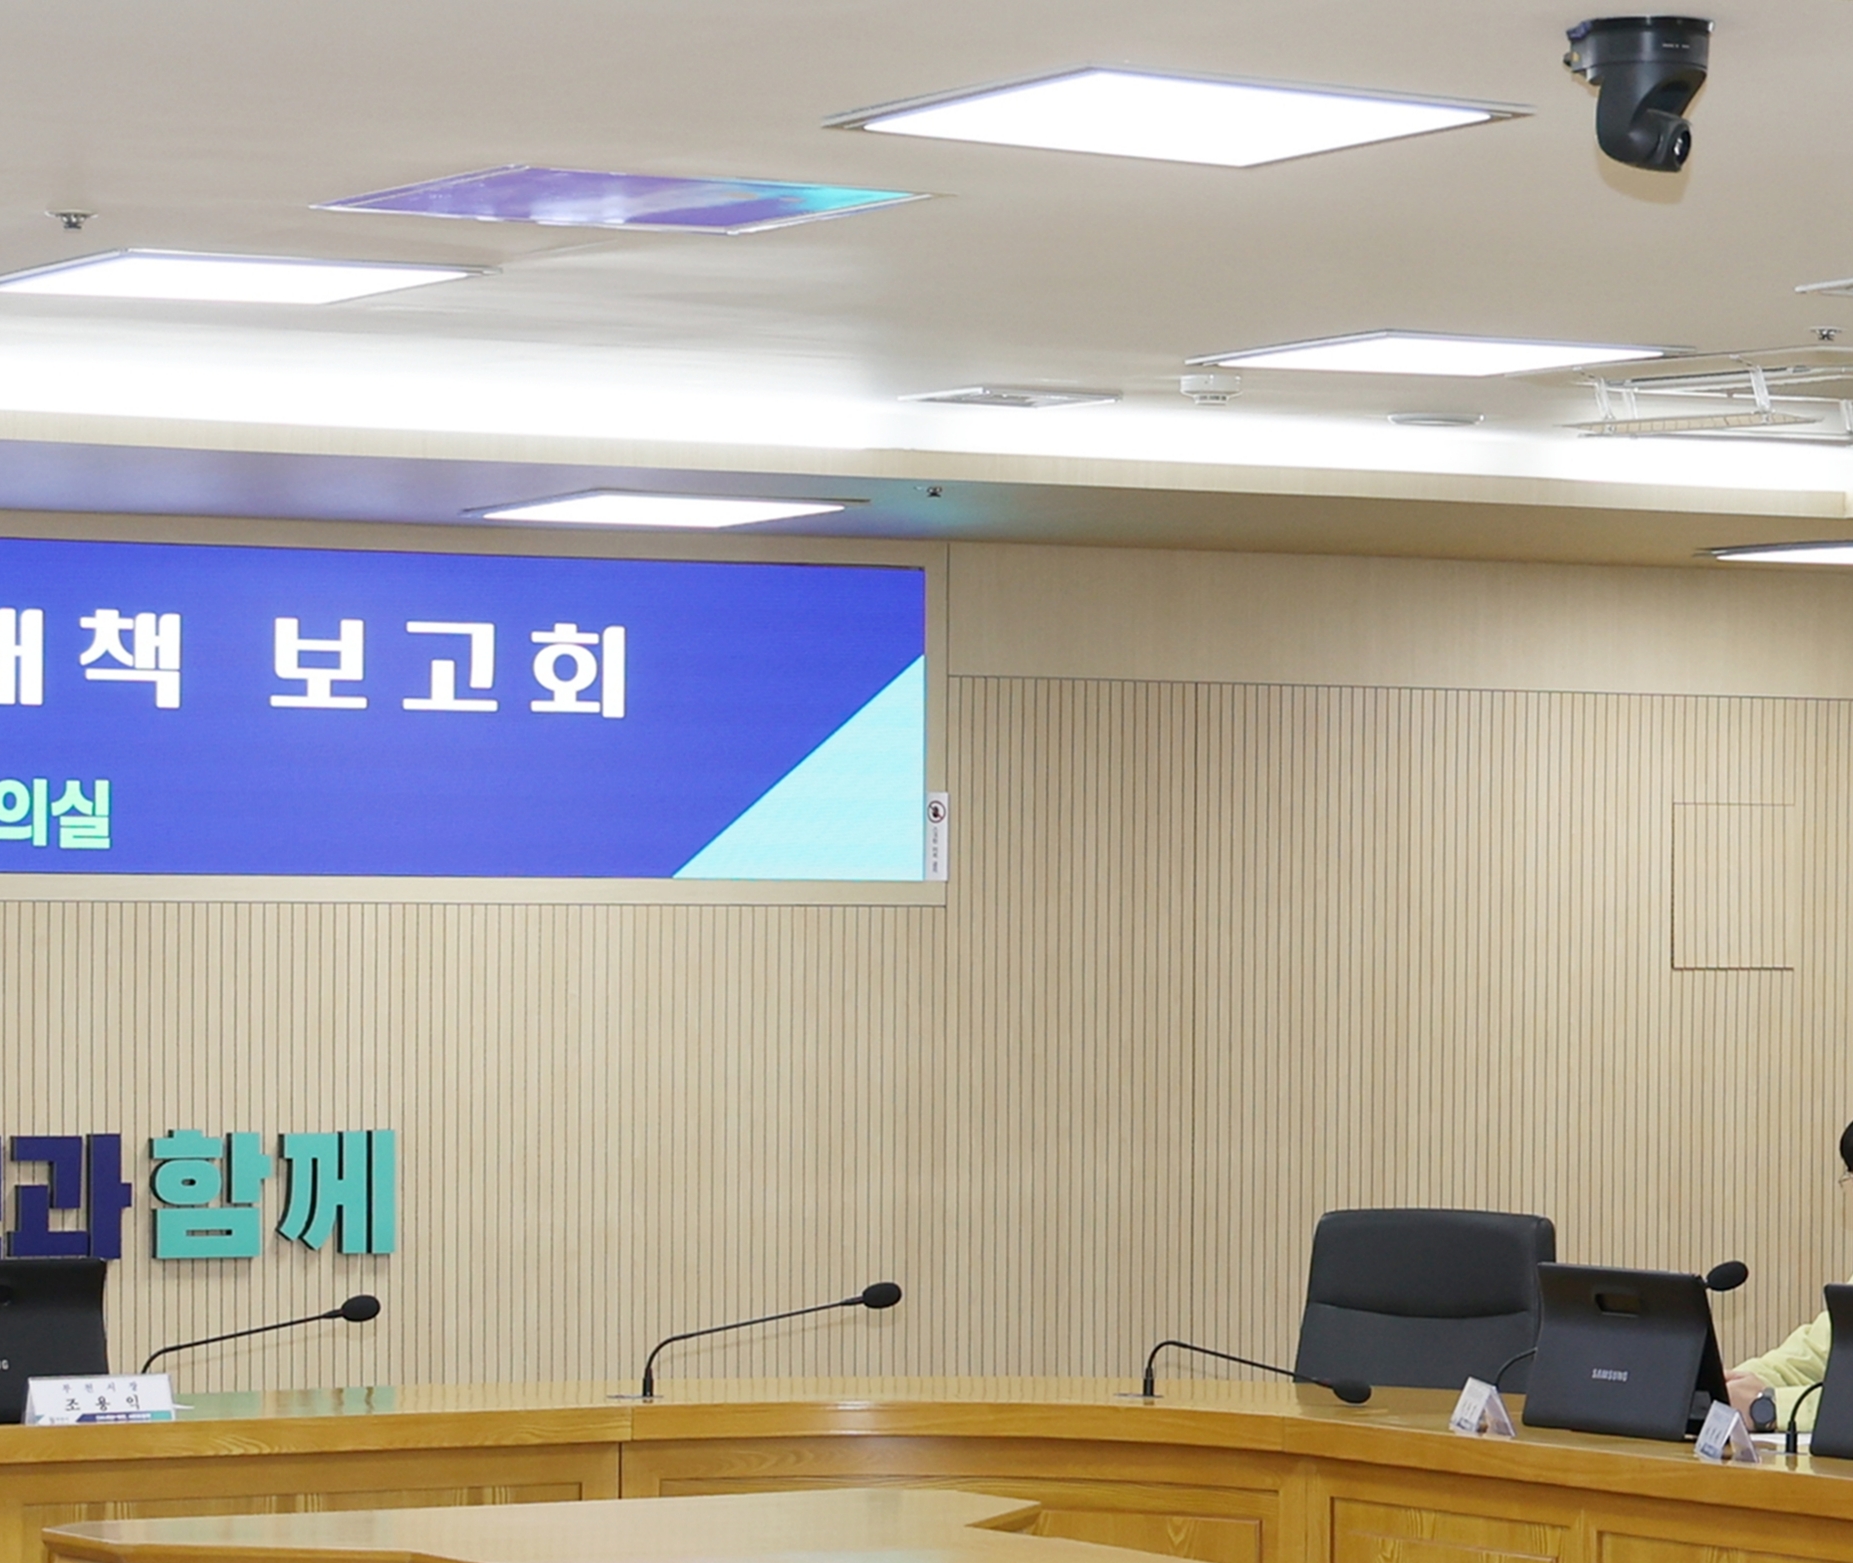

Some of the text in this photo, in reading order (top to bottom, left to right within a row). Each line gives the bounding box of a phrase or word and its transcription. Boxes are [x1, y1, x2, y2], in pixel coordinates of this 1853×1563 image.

[267, 614, 628, 720] 보고회
[148, 1129, 395, 1260] 함께
[1590, 1367, 1629, 1383] SAMSUNG
